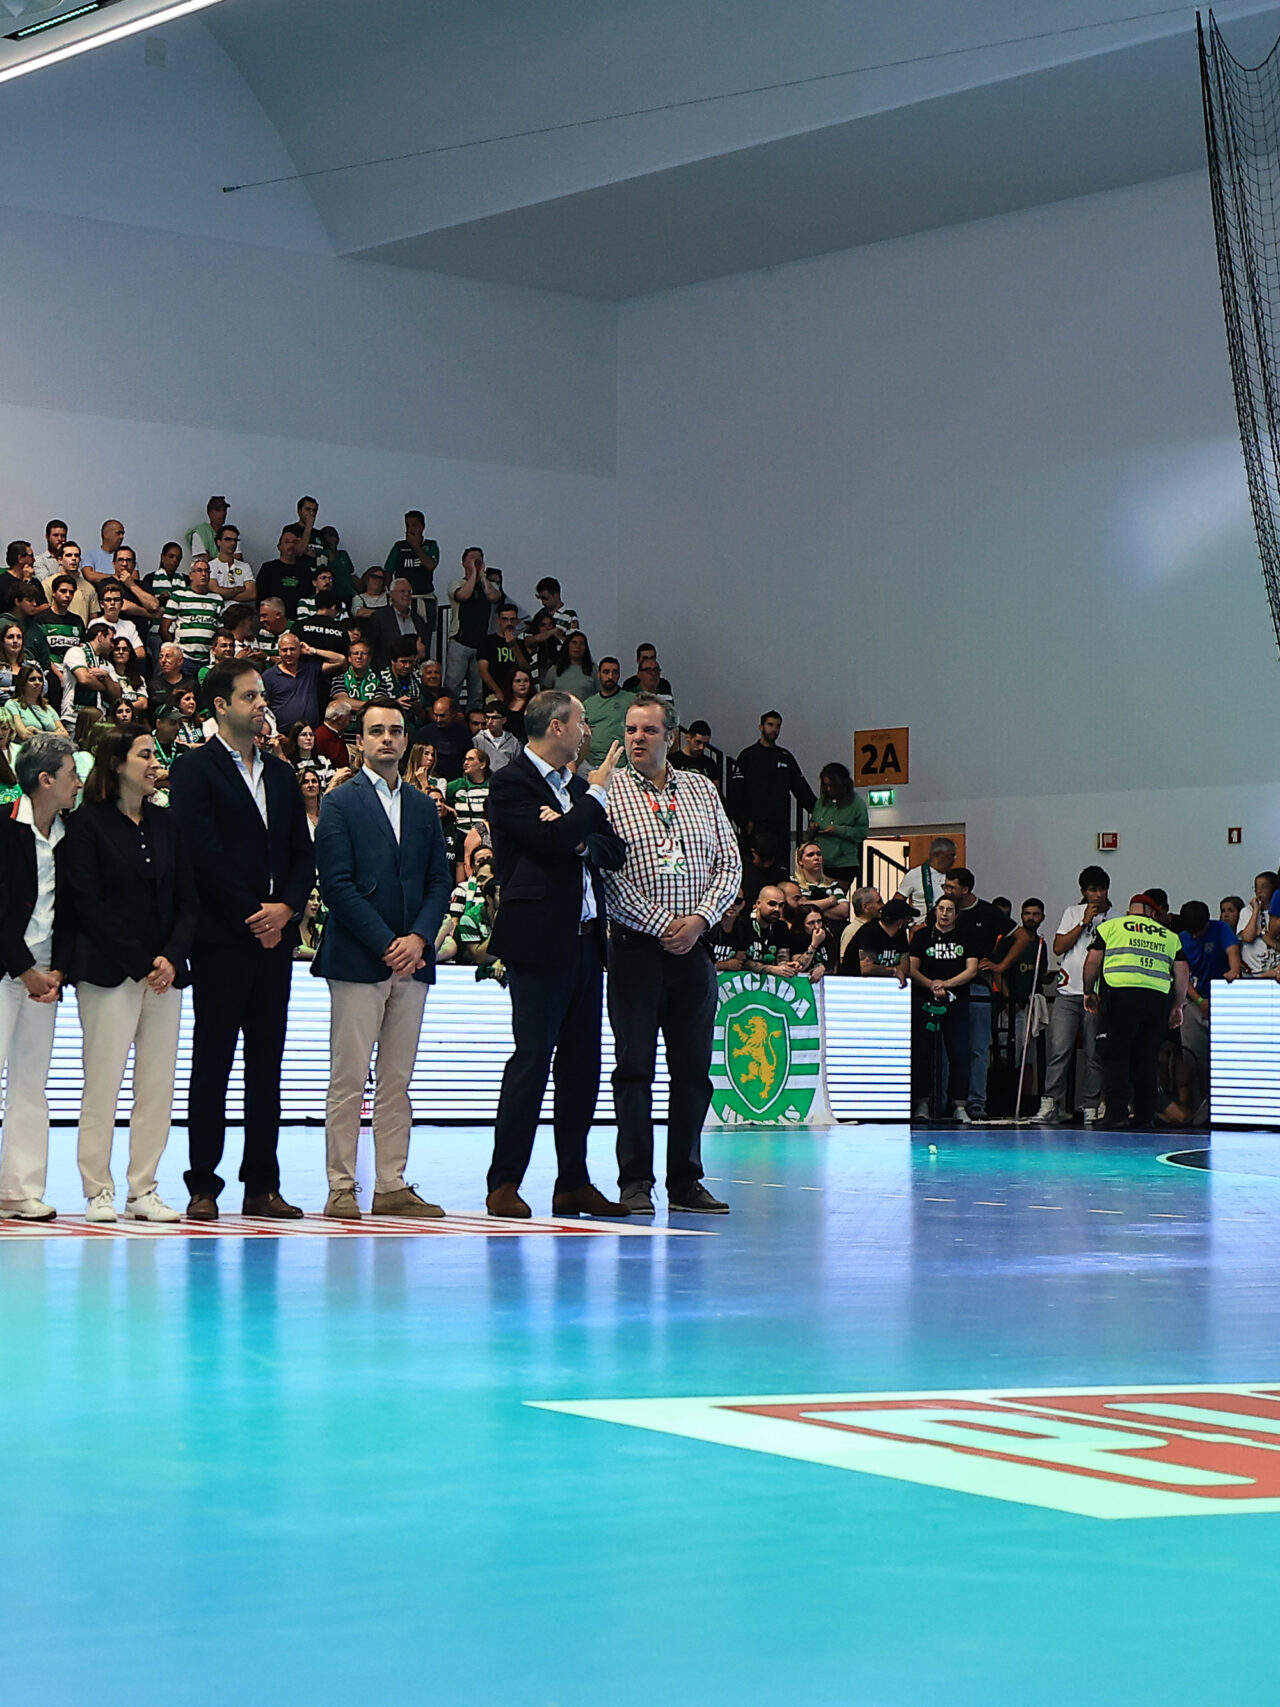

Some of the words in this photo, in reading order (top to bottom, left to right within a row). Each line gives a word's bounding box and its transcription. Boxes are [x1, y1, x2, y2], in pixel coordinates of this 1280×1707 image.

[303, 625, 324, 634] SUPER
[325, 628, 343, 637] BOCK
[861, 743, 902, 775] 2A
[1129, 938, 1166, 953] ASSISTENTE
